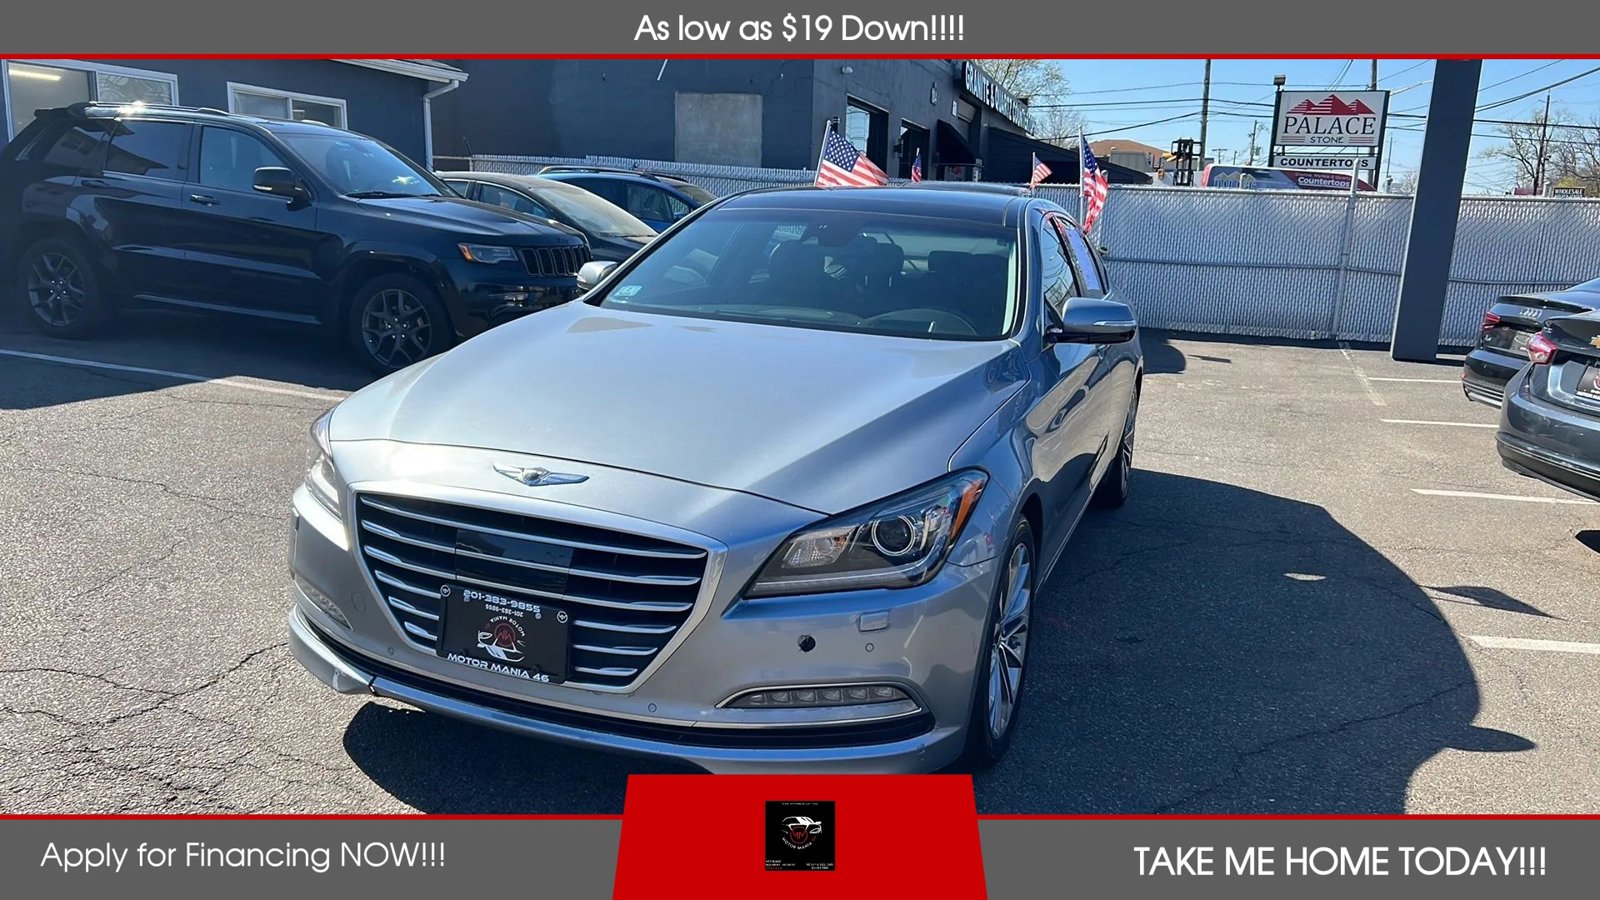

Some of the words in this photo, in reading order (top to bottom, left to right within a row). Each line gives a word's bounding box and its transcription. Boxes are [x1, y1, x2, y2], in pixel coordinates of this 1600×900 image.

[1282, 116, 1376, 135] PALACE
[1310, 136, 1344, 144] STONE
[1280, 158, 1369, 167] COUNTERTOS
[463, 589, 541, 613] 201-383-9855
[447, 653, 489, 670] MOTOR
[490, 663, 530, 679] MANIA
[532, 673, 550, 682] 46
